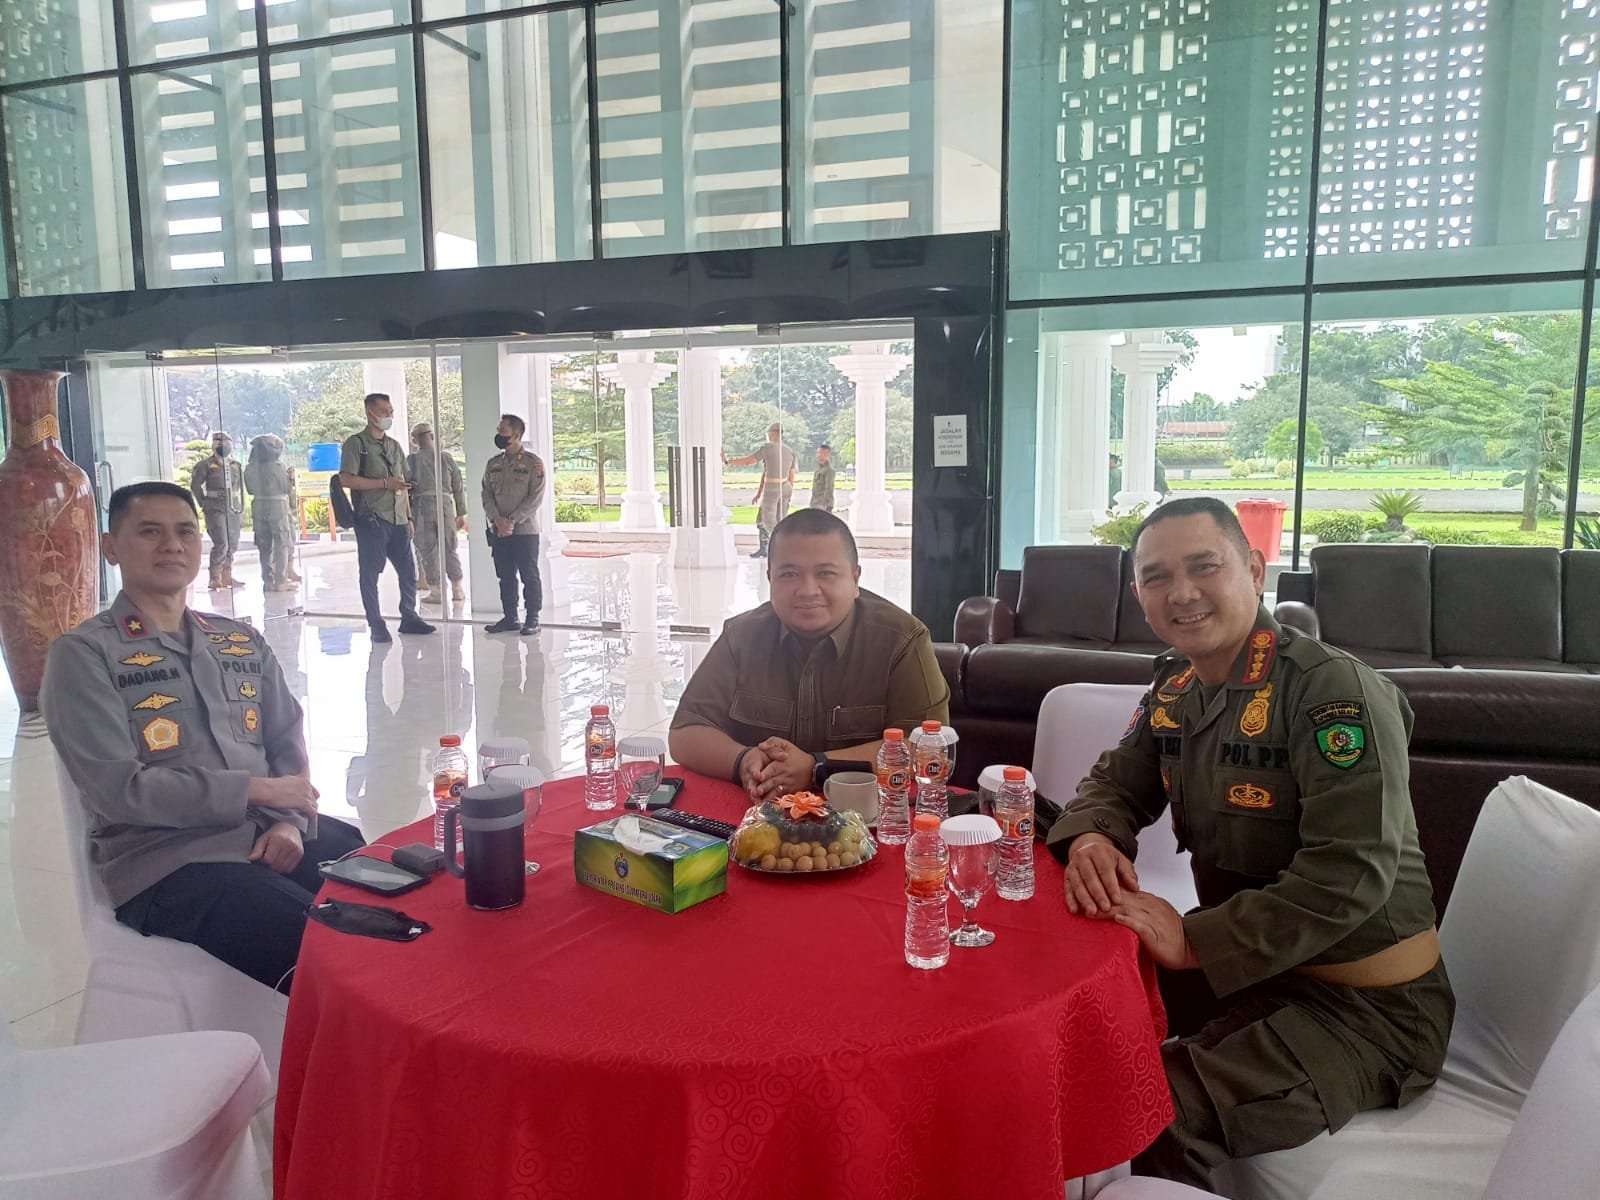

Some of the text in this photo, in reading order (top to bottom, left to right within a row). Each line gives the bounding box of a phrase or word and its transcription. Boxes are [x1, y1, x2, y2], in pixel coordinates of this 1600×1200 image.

[221, 660, 262, 674] POLRI
[1221, 742, 1290, 769] POL PP
